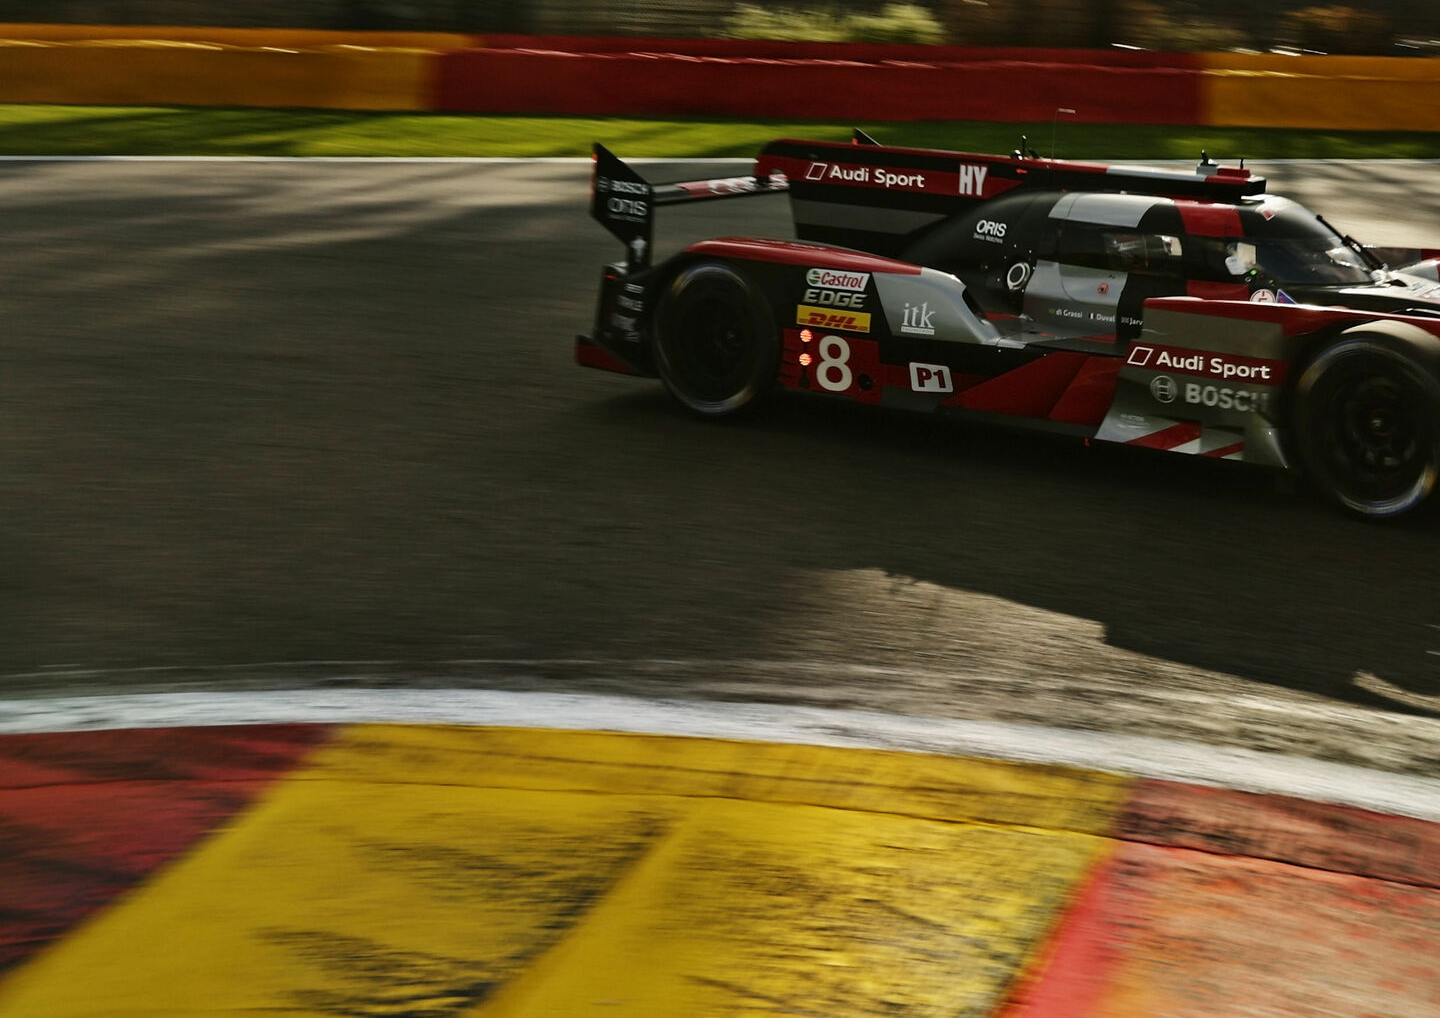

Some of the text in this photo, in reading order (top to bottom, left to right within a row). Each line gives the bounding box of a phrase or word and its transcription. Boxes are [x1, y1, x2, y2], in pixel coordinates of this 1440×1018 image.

[829, 165, 925, 188] Audi Sport
[959, 164, 987, 196] HY
[976, 219, 1007, 237] ORIS
[820, 272, 864, 289] Castrol
[803, 288, 868, 309] EDGE
[807, 312, 859, 330] DHL
[902, 302, 936, 329] itk
[1129, 318, 1143, 326] Jarv
[816, 335, 853, 392] 8
[1156, 351, 1272, 380] Audi Sport
[916, 367, 947, 389] P1
